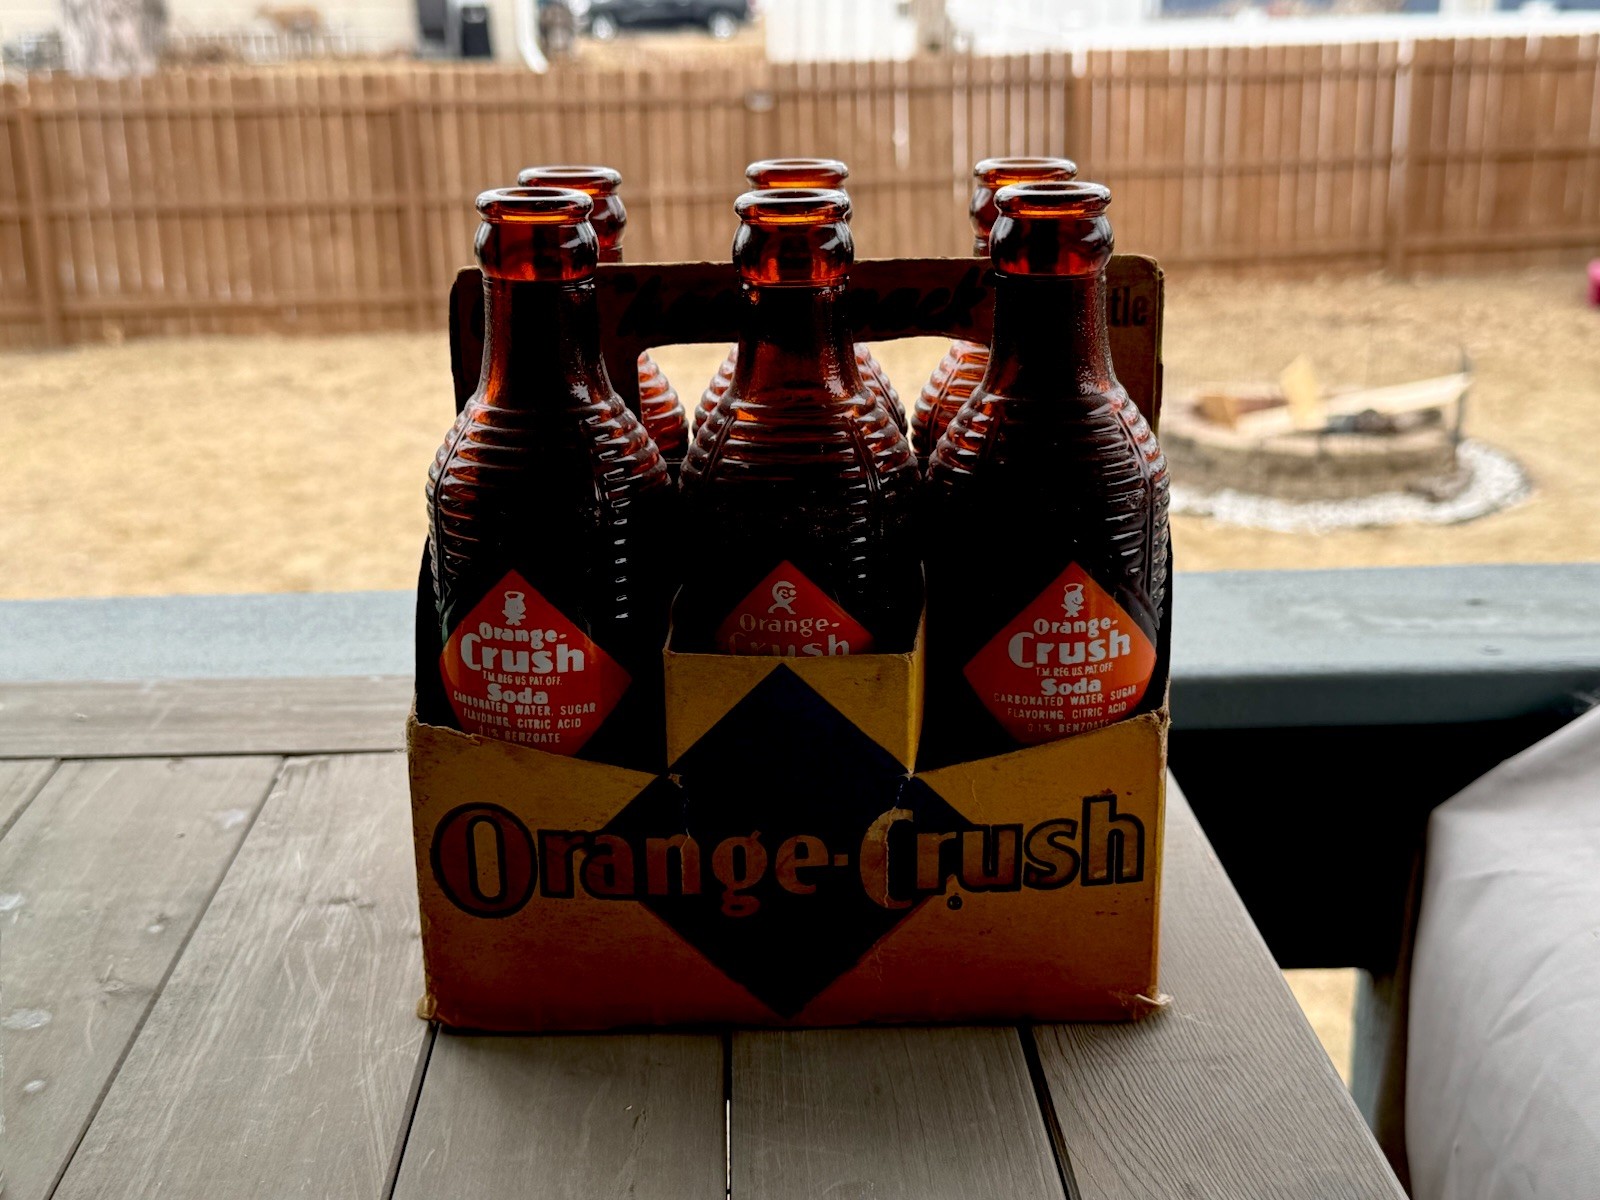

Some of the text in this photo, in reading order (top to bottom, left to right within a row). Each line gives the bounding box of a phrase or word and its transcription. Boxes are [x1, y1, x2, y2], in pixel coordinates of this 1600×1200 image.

[478, 621, 568, 650] Orange-
[738, 612, 840, 638] Orange-
[1033, 617, 1119, 638] Orange-
[460, 632, 585, 674] Crush
[1007, 629, 1131, 669] Crush
[487, 682, 549, 704] Soda
[993, 692, 1064, 707] CARBONATED
[1110, 685, 1137, 701] SUGAR
[1040, 677, 1102, 696] Soda
[453, 690, 509, 713] CARBONATED
[560, 702, 596, 716] SUGAR
[1072, 706, 1103, 720] CITRIC
[1107, 701, 1127, 715] ACID
[517, 717, 551, 730] CITRIC
[557, 717, 582, 729] ACID
[504, 729, 561, 744] BENZOATE
[429, 793, 1145, 919] Orange-Crush
